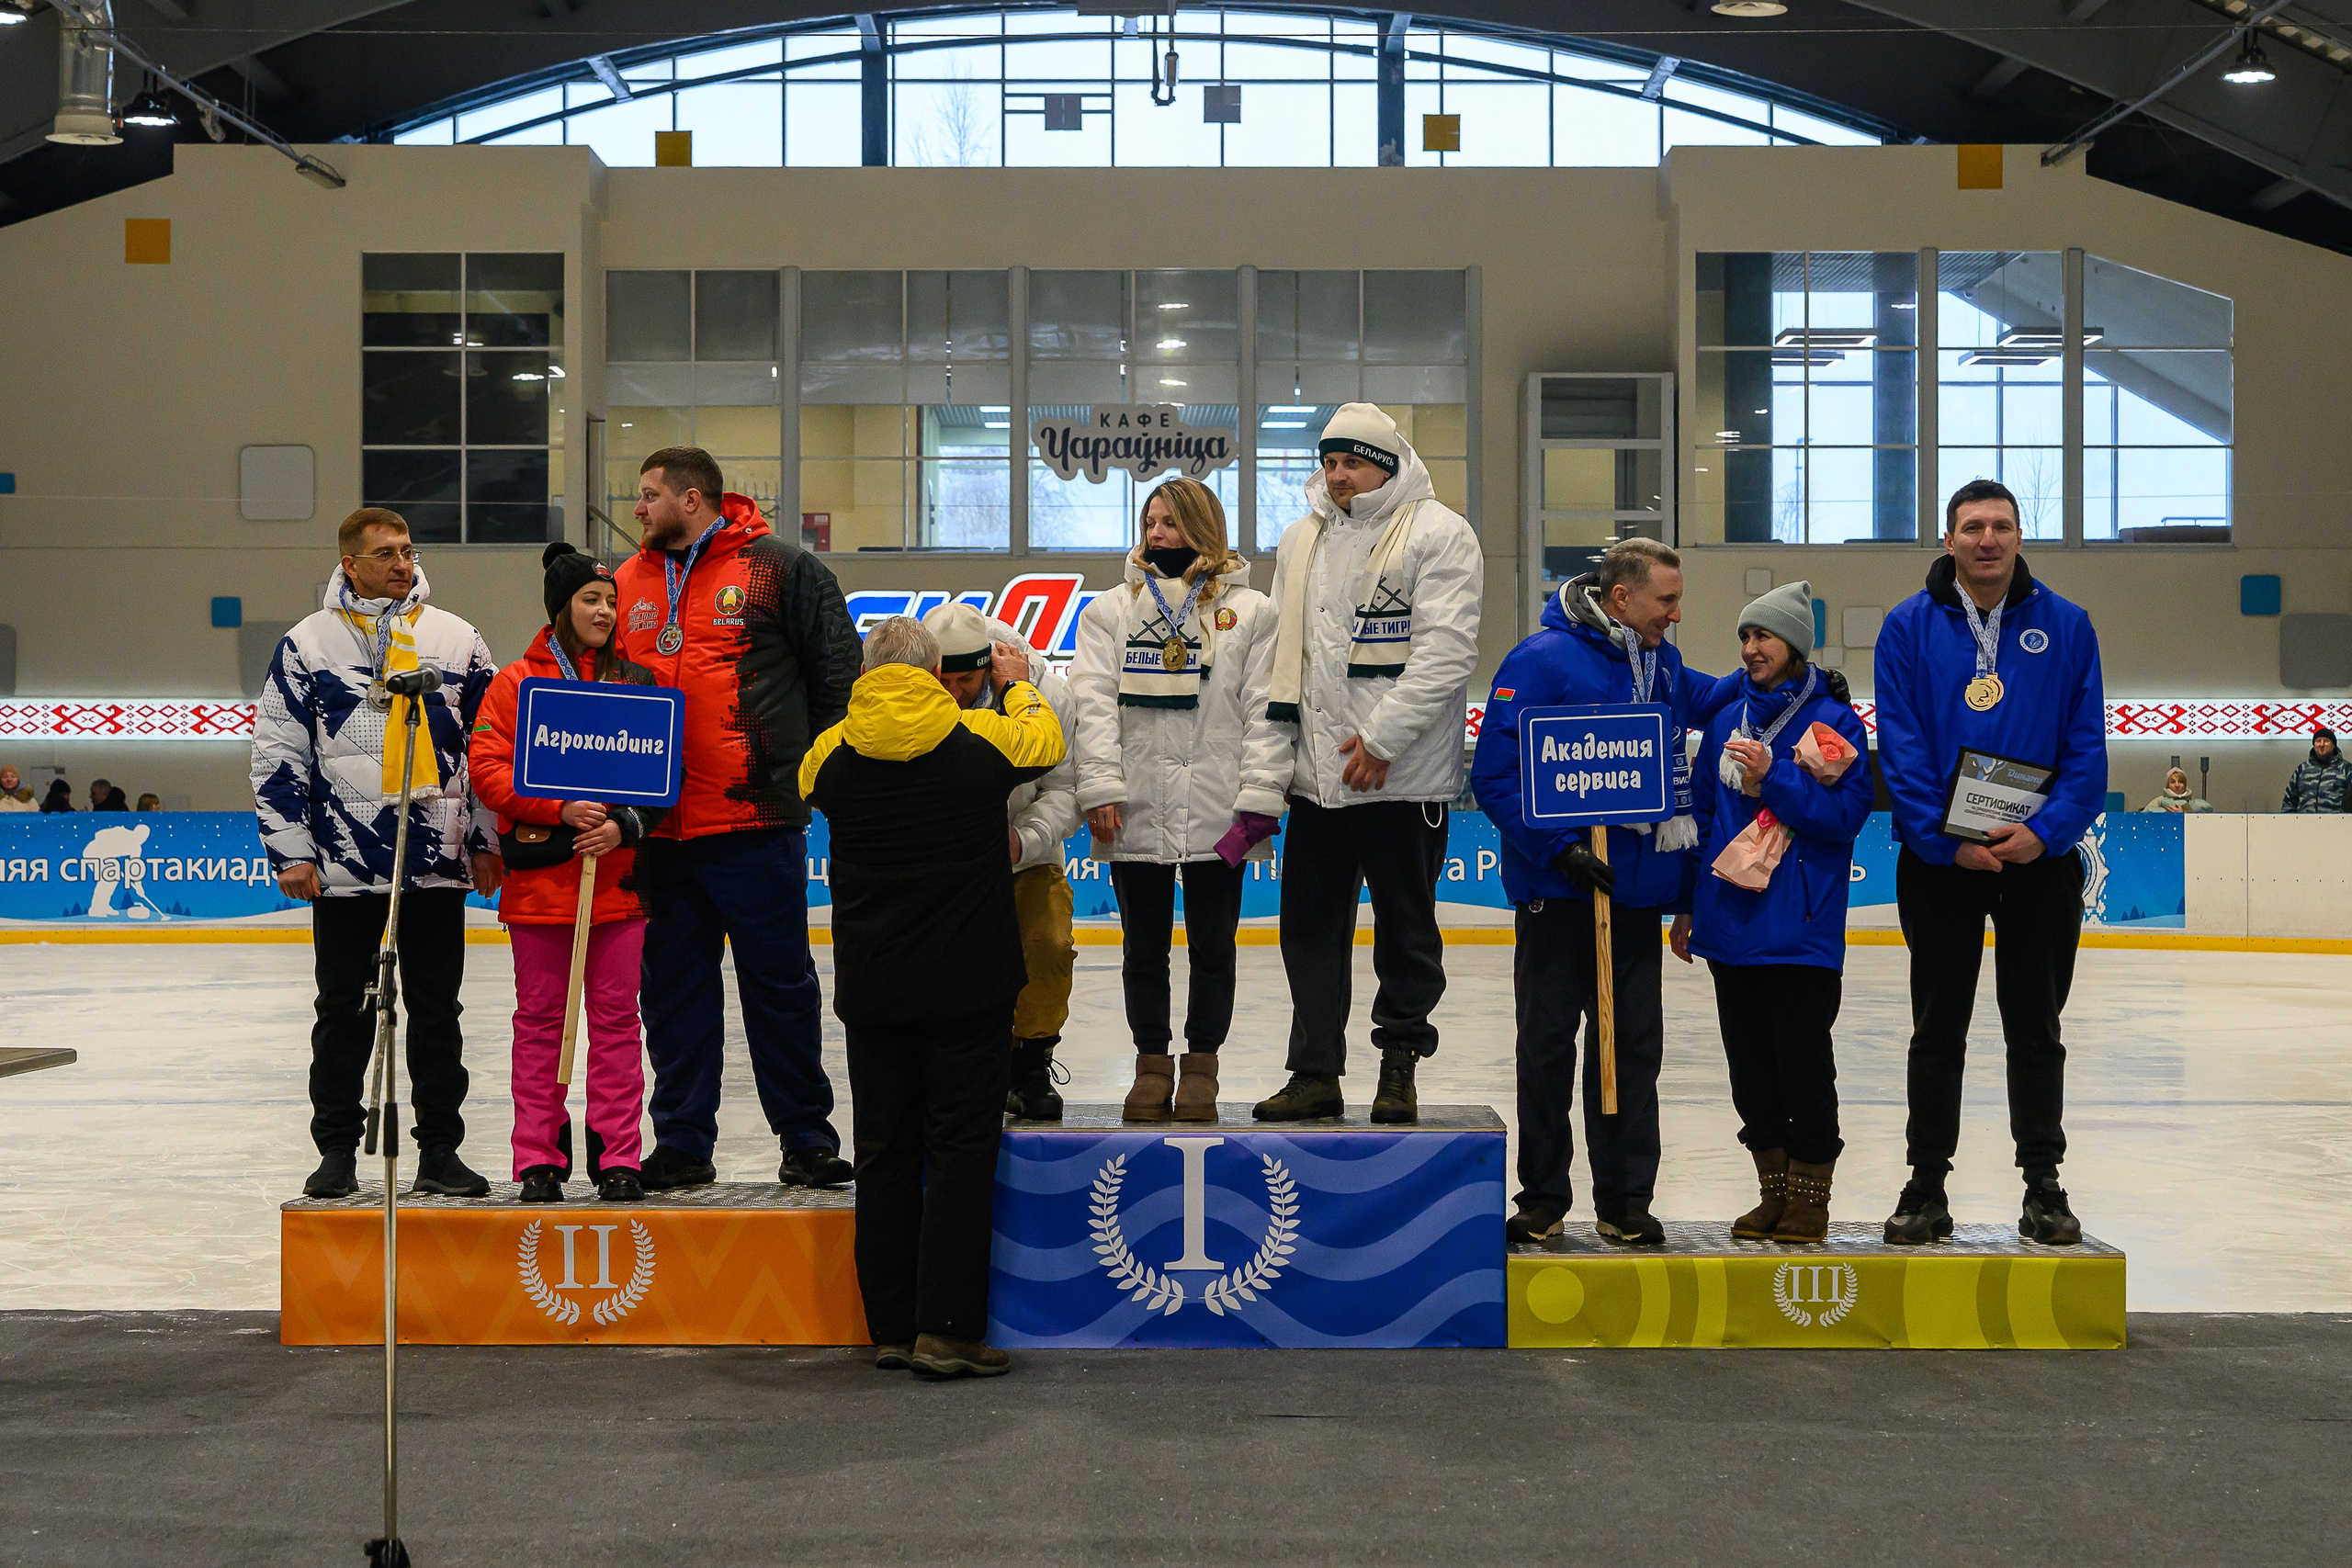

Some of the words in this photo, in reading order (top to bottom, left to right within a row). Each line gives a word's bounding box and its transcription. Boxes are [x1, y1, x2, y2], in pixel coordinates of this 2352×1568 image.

[1100, 412, 1170, 428] КАФЕ
[1040, 426, 1229, 475] Чараўніца
[1353, 444, 1395, 467] БЕЛАРУСЬ
[1125, 651, 1161, 665] БЕЛЫЕ
[534, 724, 664, 755] Агрохолдинг
[1541, 732, 1653, 762] Академия
[1555, 770, 1641, 798] сервиса
[1966, 792, 2031, 817] СЕРТИФИКАТ
[59, 857, 279, 888] спартакиад
[553, 1224, 619, 1289] II
[1788, 1266, 1844, 1303] III
